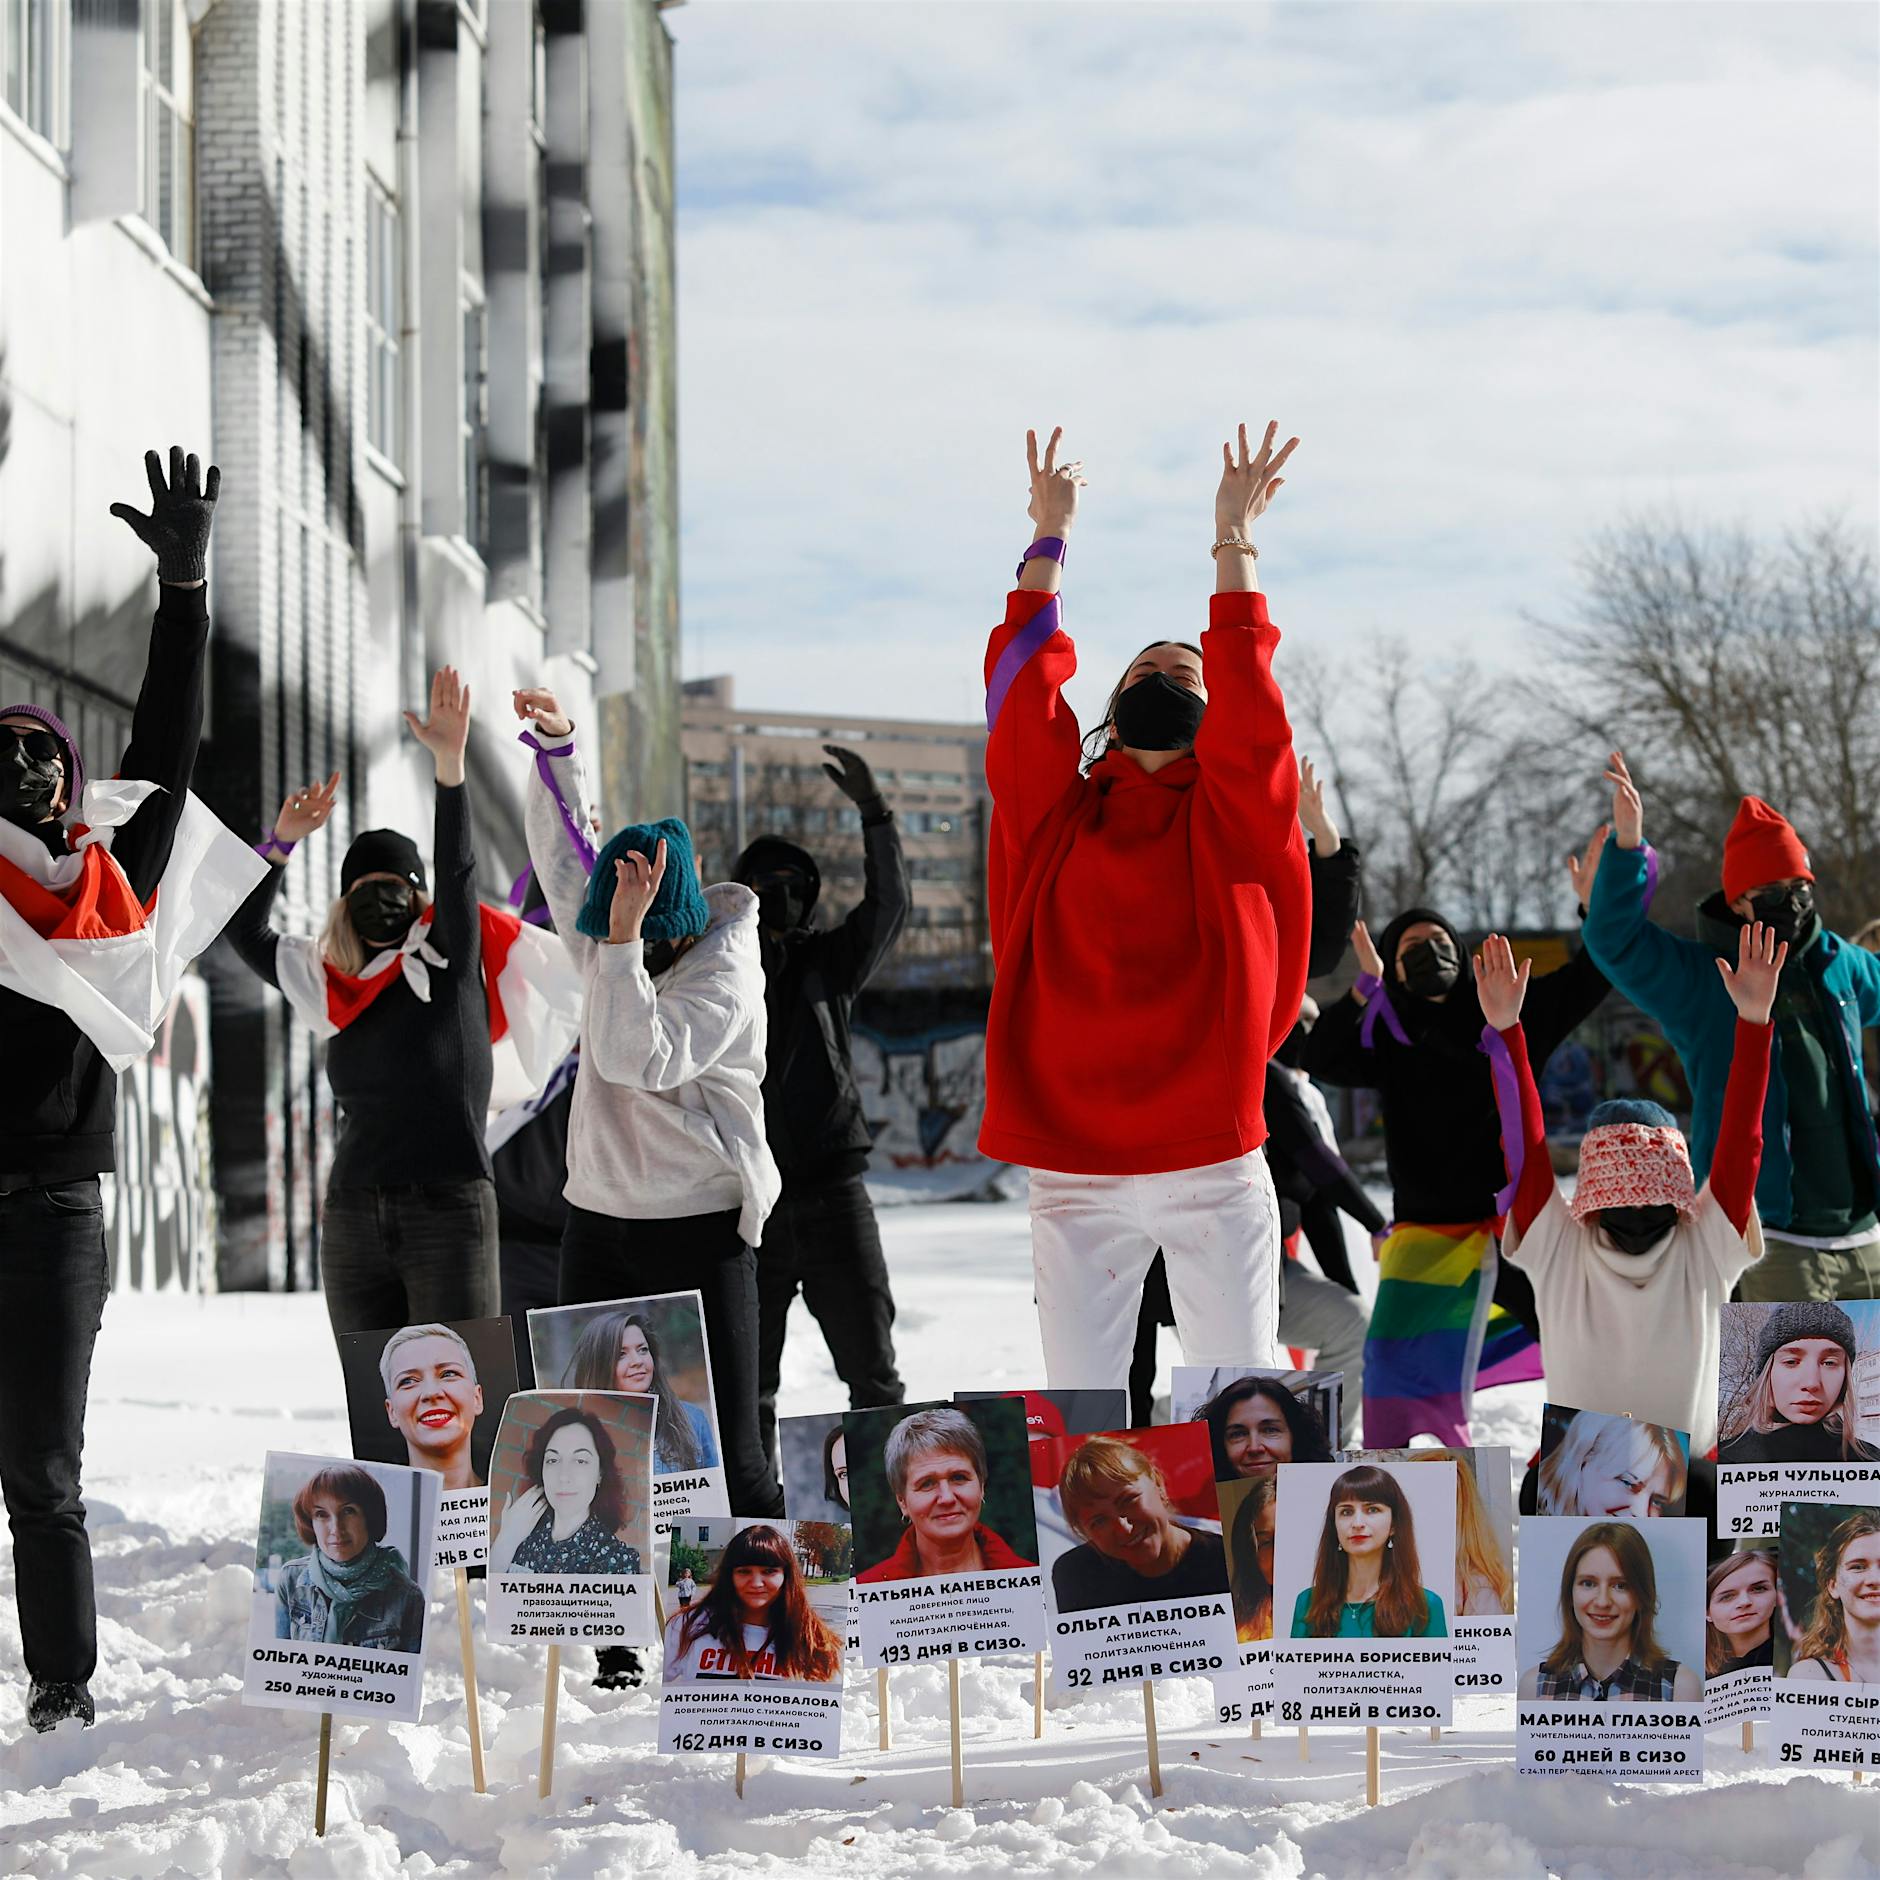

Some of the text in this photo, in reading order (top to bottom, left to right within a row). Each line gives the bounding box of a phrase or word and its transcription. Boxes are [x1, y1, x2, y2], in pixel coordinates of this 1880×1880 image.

[1721, 1469, 1880, 1485] ДАРЬЯ ЧУЛЬЦОВА
[1759, 1490, 1839, 1498] ЖУРНАЛИСТКА,
[1731, 1517, 1753, 1533] 92
[458, 1550, 468, 1561] В
[500, 1582, 637, 1596] ТАТЬЯНА ЛАСИЦА
[858, 1585, 935, 1604] ТАТЬЯНА
[940, 1575, 1041, 1594] КАНЕВСКАЯ
[522, 1599, 612, 1608] правозащитница,
[909, 1597, 990, 1611] ДОВЕРЕННОЕ ЛИЦО
[517, 1610, 615, 1619] политзаключённая
[890, 1613, 946, 1625] КАНДИДАТКИ
[956, 1607, 1015, 1618] ПРЕЗИДЕНТЫ,
[1056, 1603, 1226, 1635] ОЛЬГА ПАВЛОВА
[510, 1624, 625, 1636] 25 дней в СИЗО
[896, 1621, 1010, 1639] ПОЛИТЗАКЛЮЧЁННАЯ.
[1106, 1628, 1181, 1643] АКТИВИСТКА,
[1454, 1627, 1512, 1638] ЕНКОВА
[880, 1637, 1026, 1664] 193 ДНЯ В СИЗО.
[1084, 1639, 1206, 1661] ПОЛИТЗАКЛЮЧЁННАЯ
[1275, 1652, 1451, 1663] КАТЕРИНА БОРИСЕВИЧ
[253, 1649, 409, 1676] ОЛЬГА РАДЕЦКАЯ
[301, 1670, 363, 1684] художница
[1067, 1656, 1223, 1687] 92 ДНЯ В СИЗО
[1318, 1670, 1404, 1679] ЖУРНАЛИСТКА,
[1454, 1674, 1503, 1686] СИЗО
[264, 1680, 396, 1704] 250 дней в СИЗО
[1303, 1684, 1422, 1694] ПОЛИТЗАКЛЮЧЁННАЯ
[664, 1693, 839, 1708] АНТОНИНА КОНОВАЛОВА
[1775, 1693, 1880, 1709] КСЕНИЯ СЫР
[674, 1707, 729, 1715] ДОВЕРЕННОЕ
[1220, 1703, 1242, 1723] 95
[1281, 1701, 1441, 1721] 88 ДНЕЙ В СИЗО.
[700, 1719, 800, 1728] ПОЛИТЗАКЛЮЧЁННАЯ
[1520, 1713, 1701, 1727] МАРИНА ГЛАЗОВА
[672, 1733, 823, 1751] 162 ДНЯ В СИЗО
[1530, 1732, 1691, 1740] УЧИТЕЛЬНИЦА, ПОЛИТЗАКЛЮЧЁННАЯ
[1534, 1747, 1686, 1764] 60 ДНЕЙ В СИЗО
[1780, 1743, 1803, 1762] 95
[1813, 1747, 1864, 1764] ДНЕЙ
[1619, 1768, 1671, 1776] ДОМАШНИЙ
